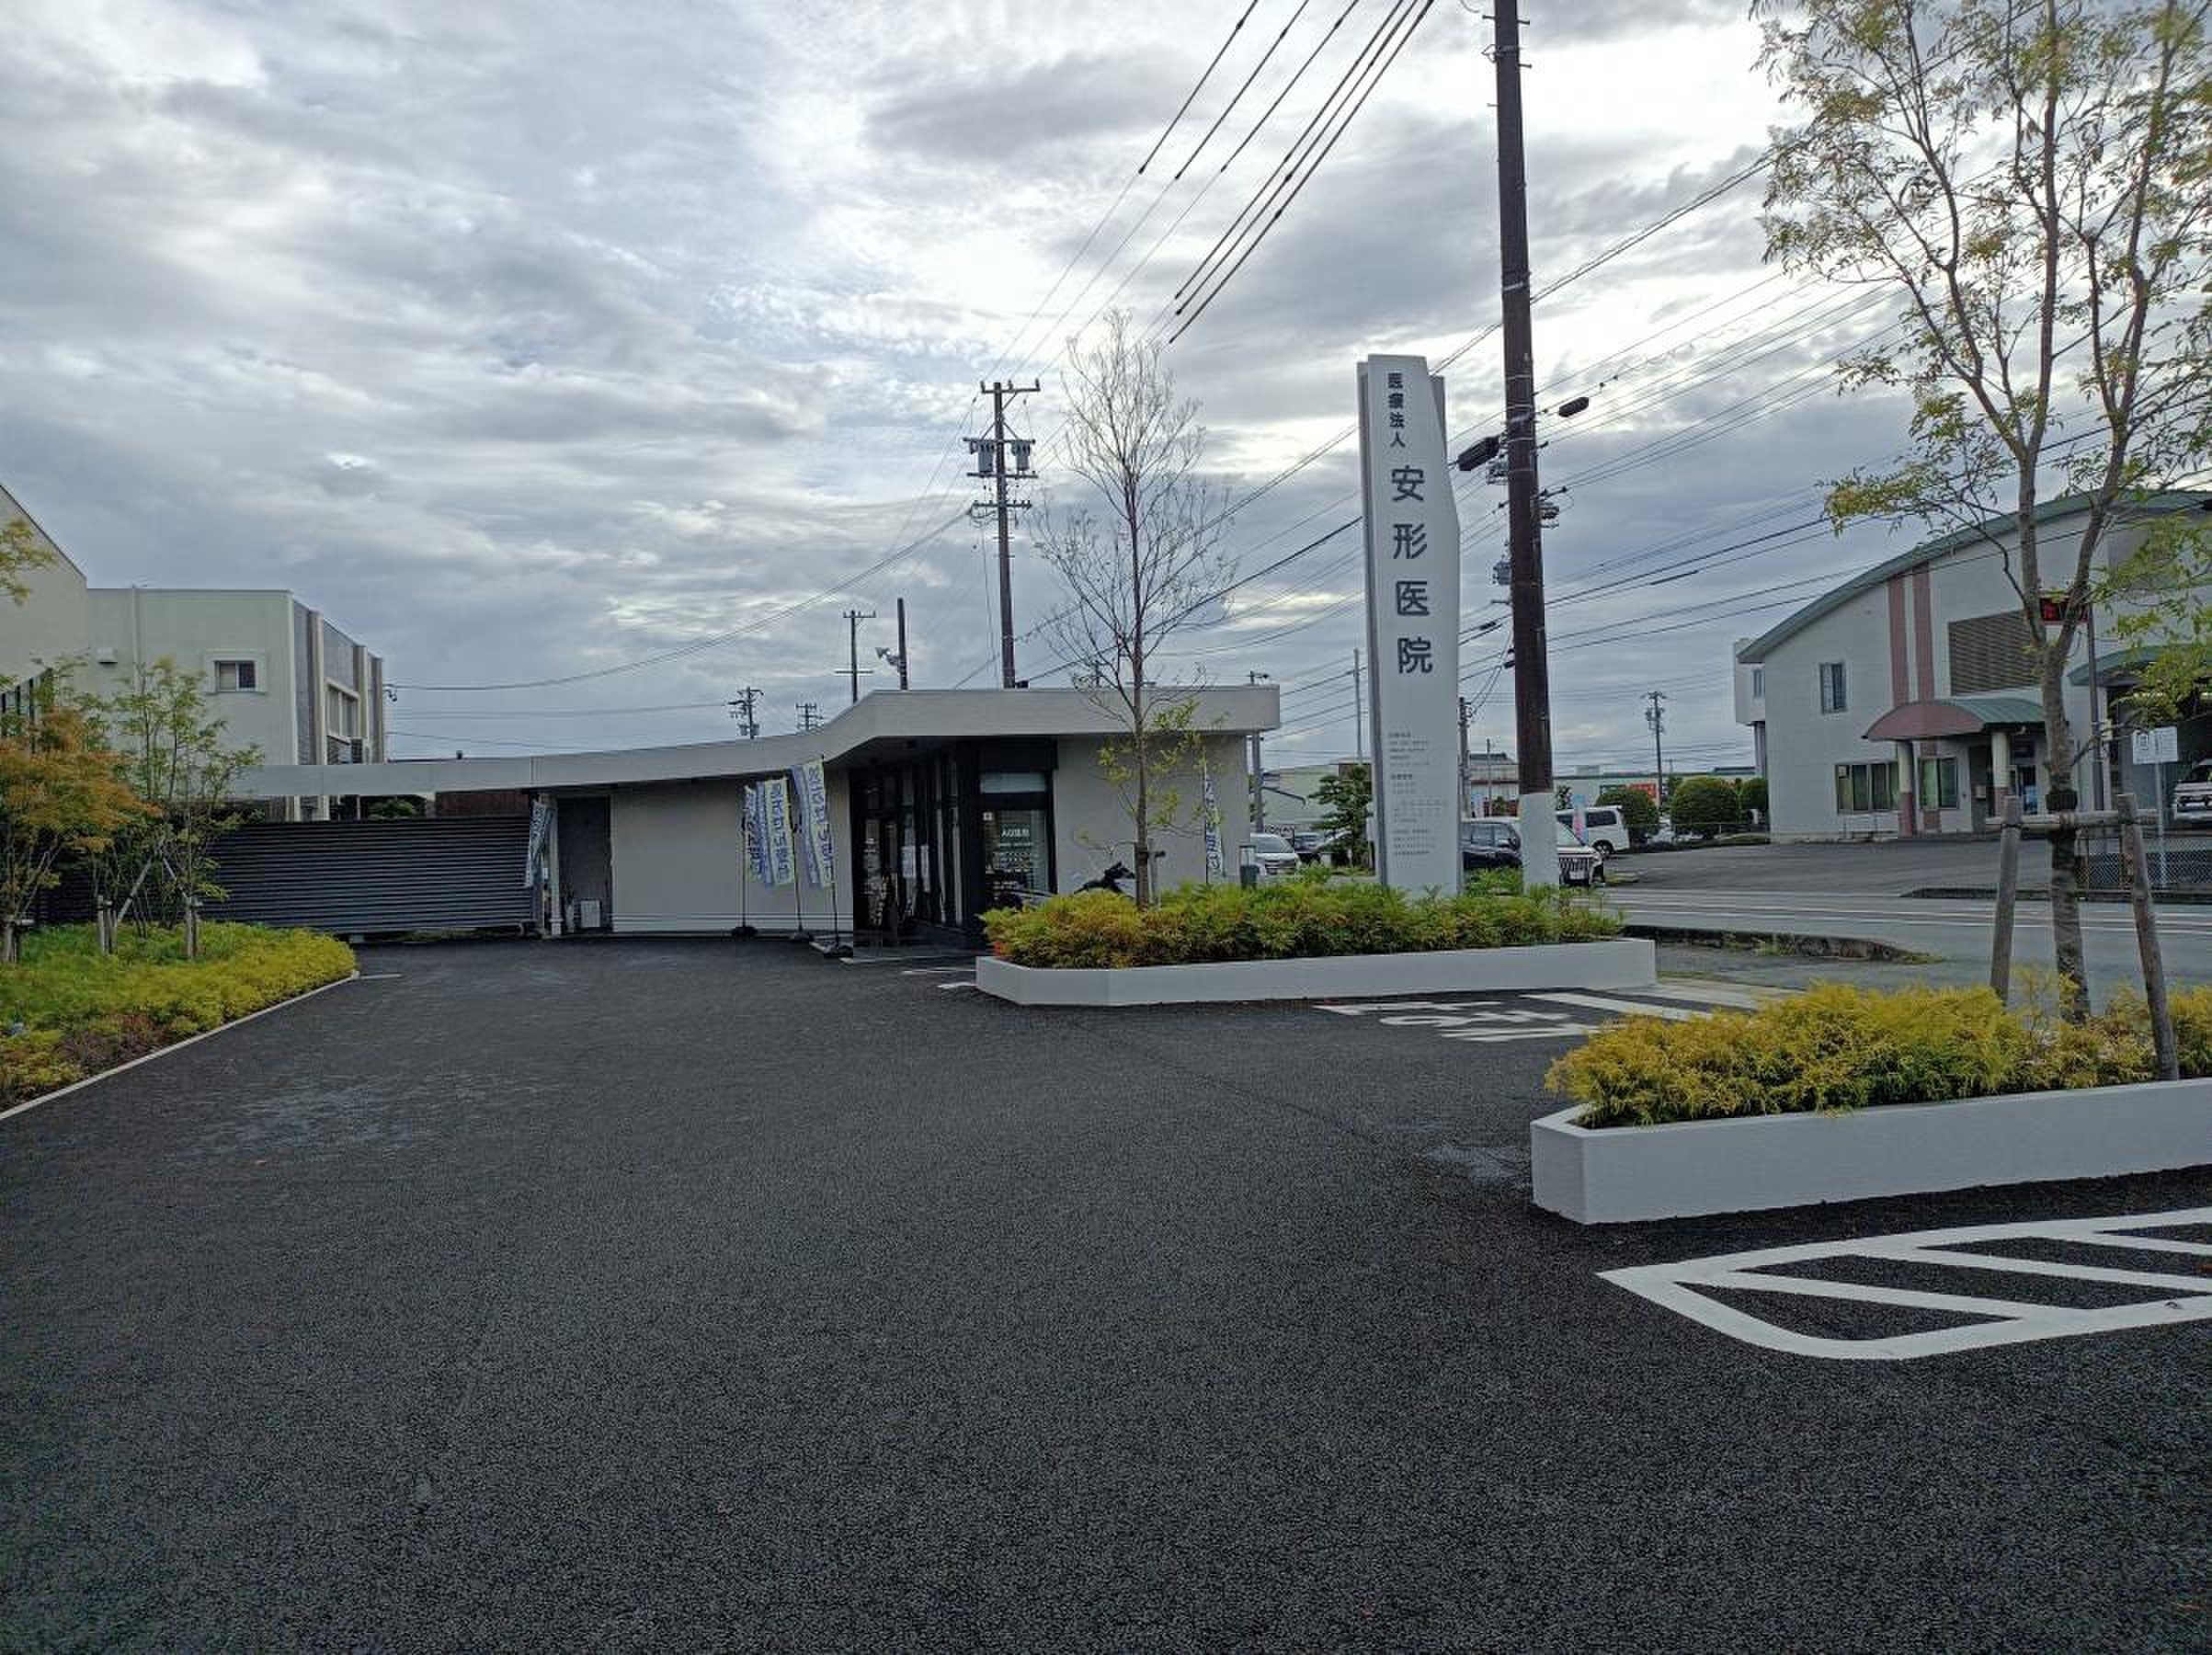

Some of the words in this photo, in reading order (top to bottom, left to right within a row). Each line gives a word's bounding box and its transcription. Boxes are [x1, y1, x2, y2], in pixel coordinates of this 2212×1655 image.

[1387, 371, 1406, 449] 医療法人
[1390, 464, 1433, 674] 安形医院
